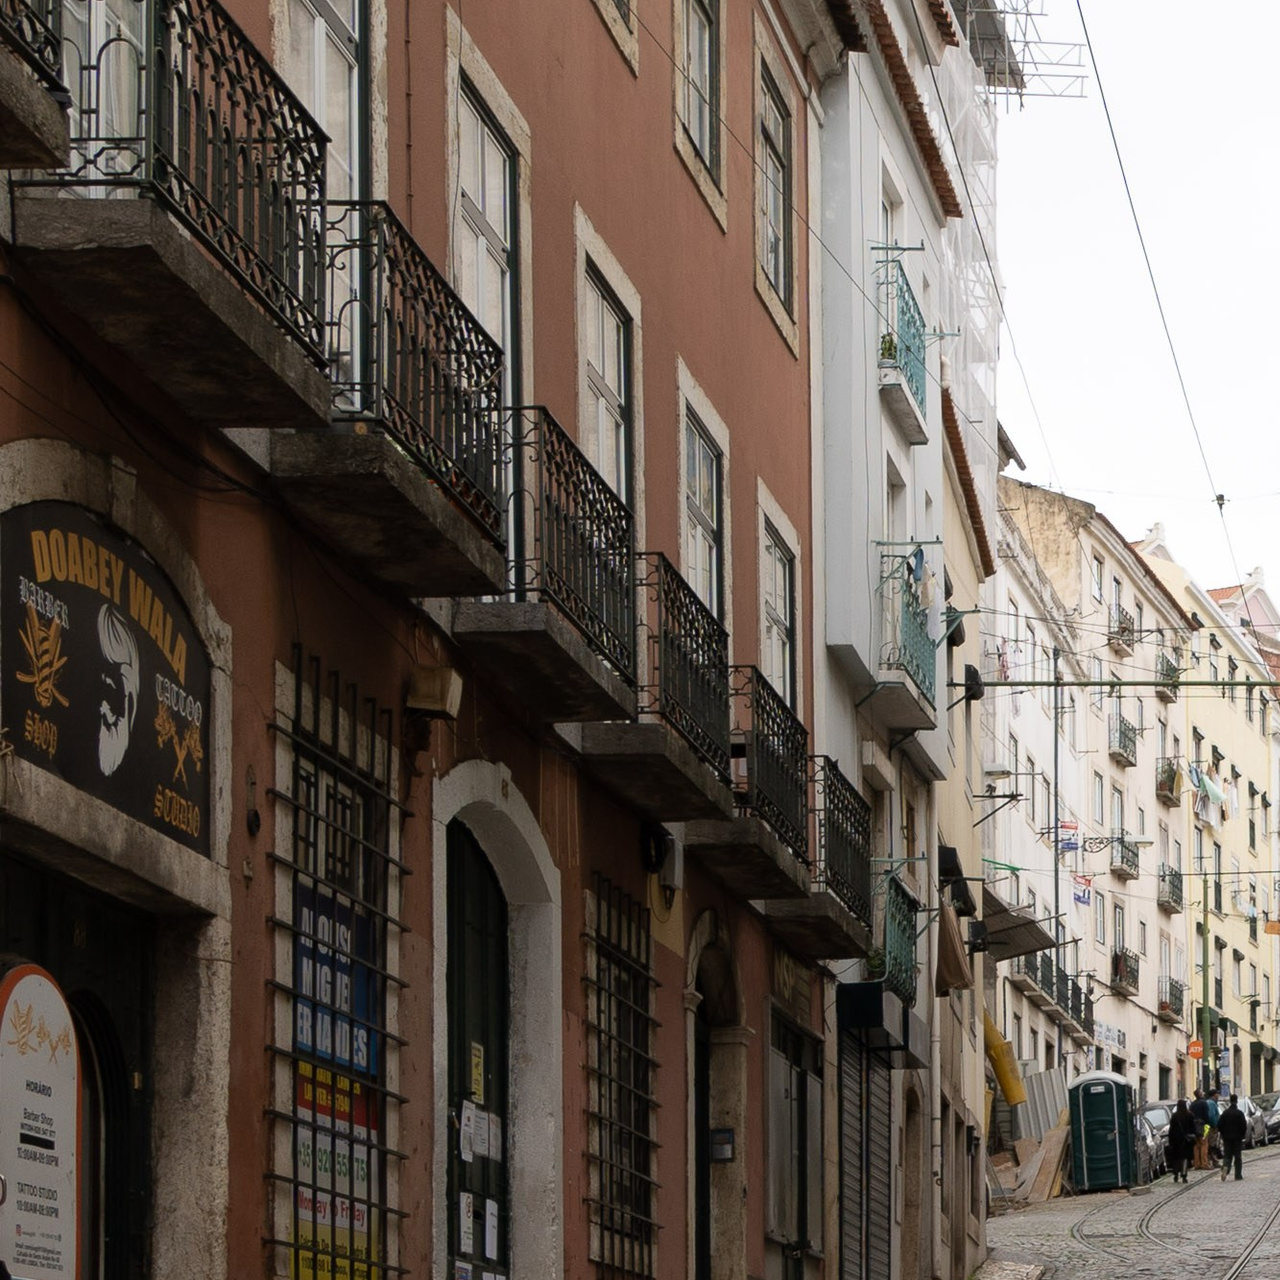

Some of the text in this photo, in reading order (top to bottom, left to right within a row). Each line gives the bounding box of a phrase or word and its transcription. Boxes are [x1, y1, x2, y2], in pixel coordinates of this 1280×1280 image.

[31, 528, 187, 686] DOABEY WALA
[155, 673, 203, 726] TATTOO
[153, 783, 200, 838] STUDIO
[297, 1003, 367, 1068] ERADES
[17, 1181, 58, 1201] TATTOO STUDIO
[298, 1190, 327, 1219] Monay
[341, 1200, 366, 1227] Frday
